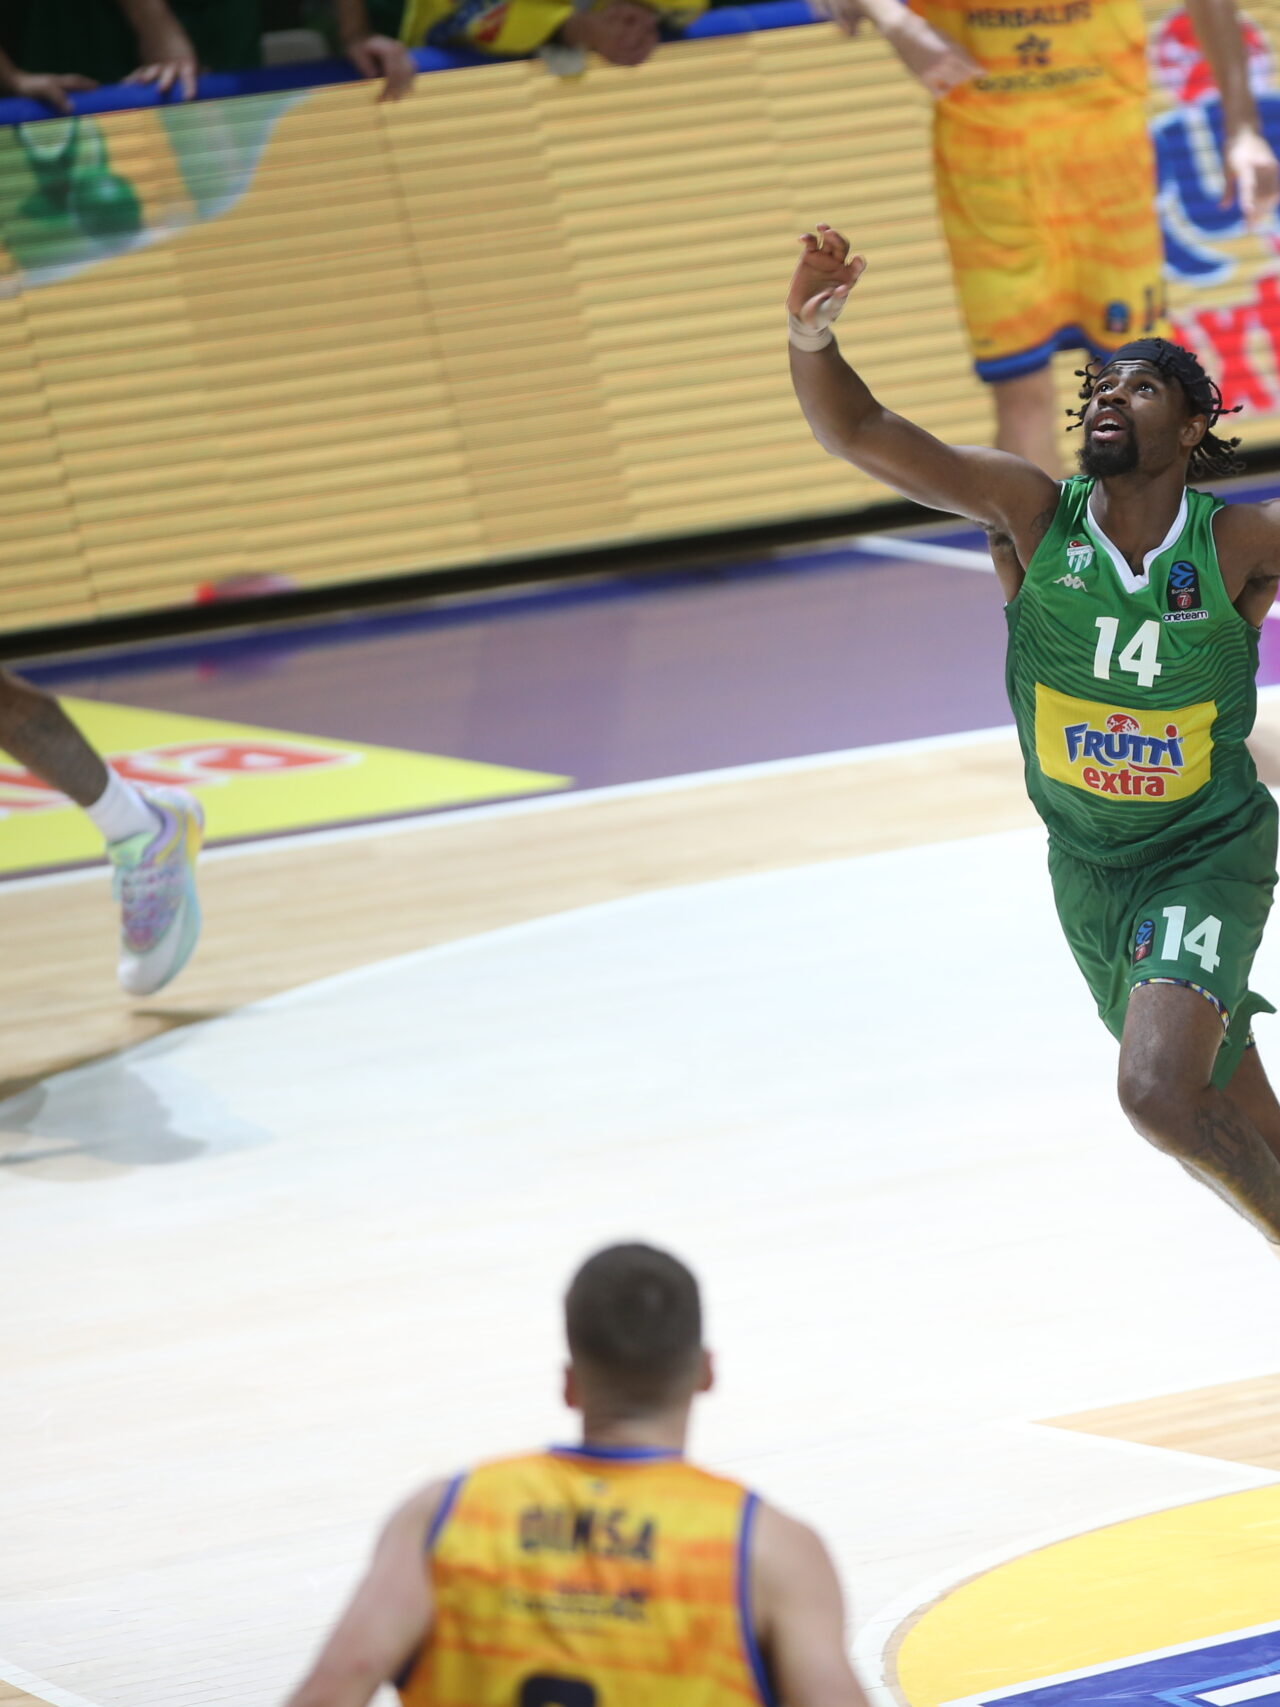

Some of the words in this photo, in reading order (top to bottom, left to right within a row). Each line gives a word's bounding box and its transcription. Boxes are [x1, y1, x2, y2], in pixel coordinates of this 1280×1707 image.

[1162, 610, 1208, 622] oneteam
[1093, 616, 1162, 688] 14
[1063, 722, 1185, 768] FRUTTI
[1082, 766, 1165, 797] extra
[1161, 905, 1222, 974] 14
